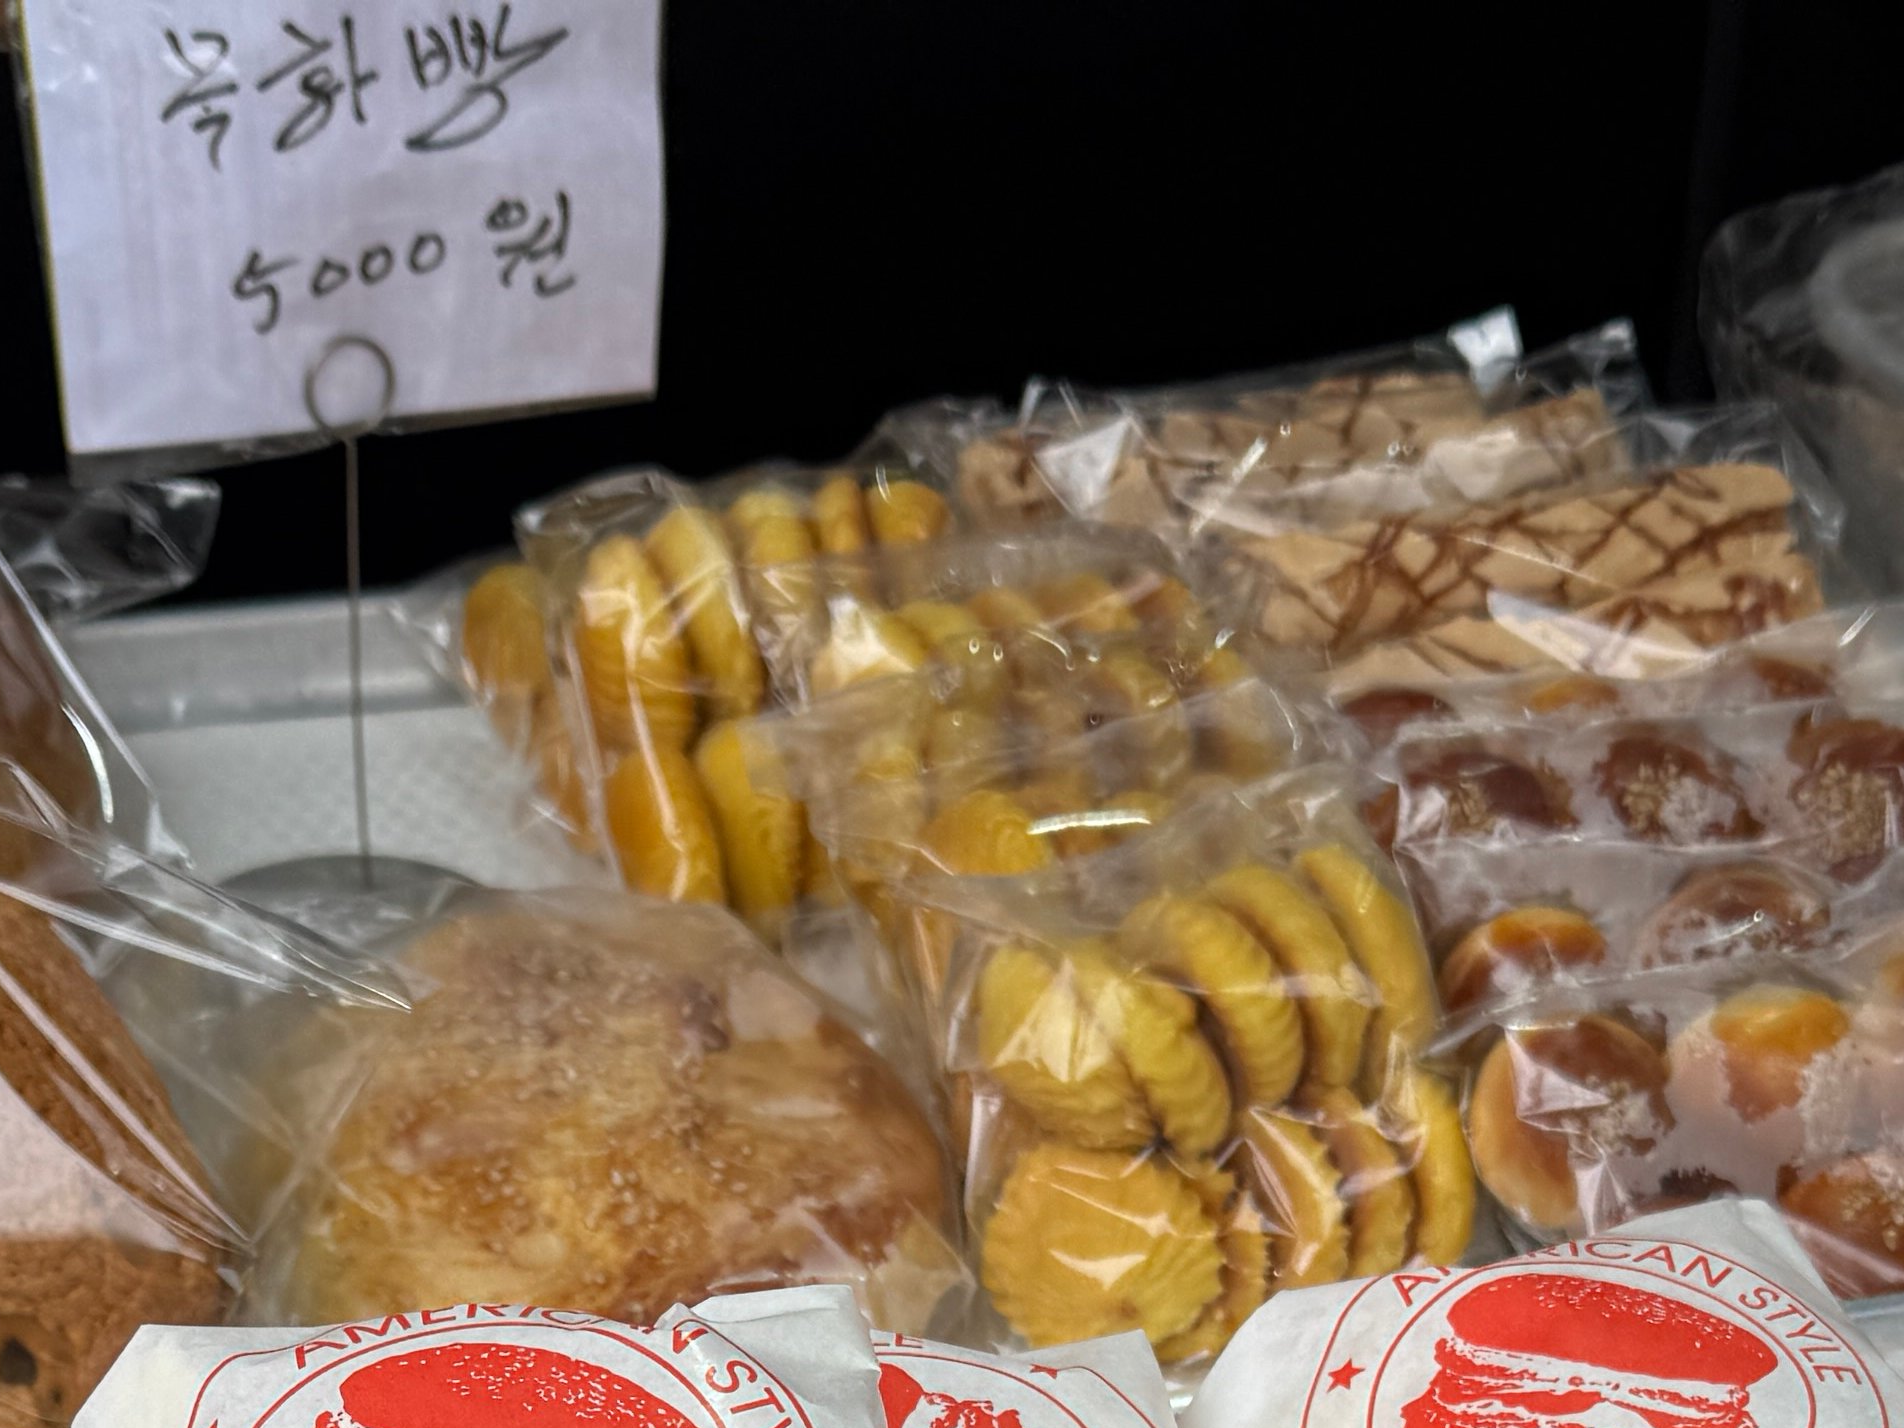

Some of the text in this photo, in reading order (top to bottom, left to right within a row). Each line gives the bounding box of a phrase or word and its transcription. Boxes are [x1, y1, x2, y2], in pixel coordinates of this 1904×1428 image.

[296, 1303, 708, 1369] AMERICN
[1392, 1239, 1863, 1387] ARICAN STYLE
